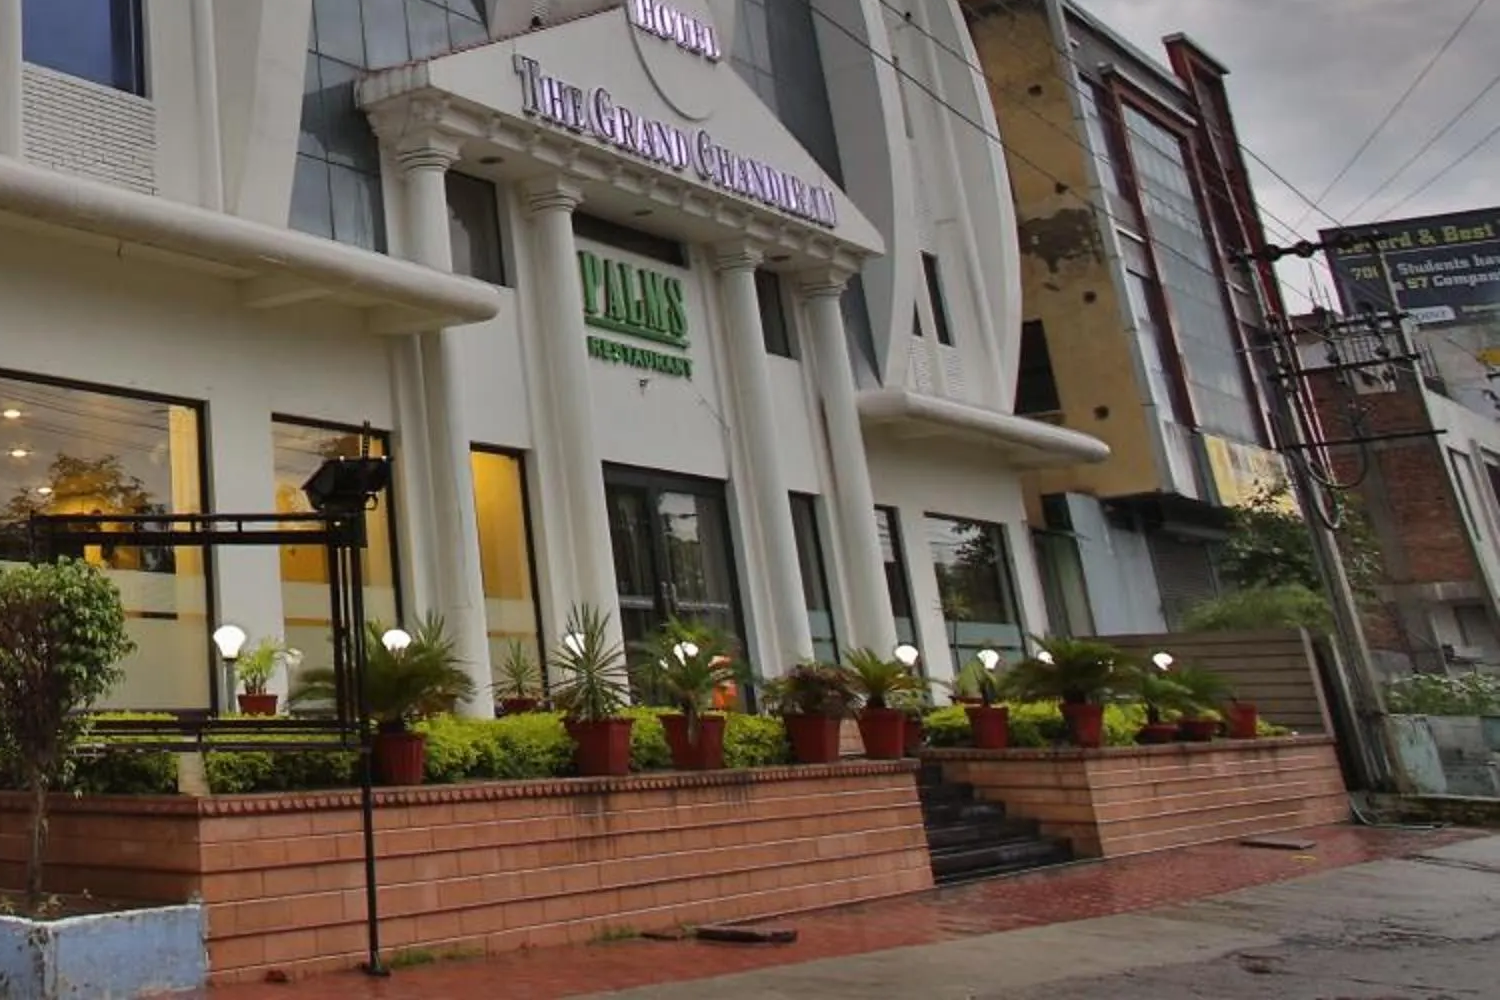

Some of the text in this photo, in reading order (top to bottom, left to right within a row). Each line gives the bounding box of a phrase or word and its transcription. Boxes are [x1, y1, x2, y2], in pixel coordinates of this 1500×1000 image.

[512, 53, 586, 135] THE
[587, 87, 691, 172] GRAND
[1441, 223, 1496, 243] Best
[1396, 257, 1471, 276] Students
[577, 250, 689, 338] PALMS
[585, 335, 692, 382] RESTAURANT
